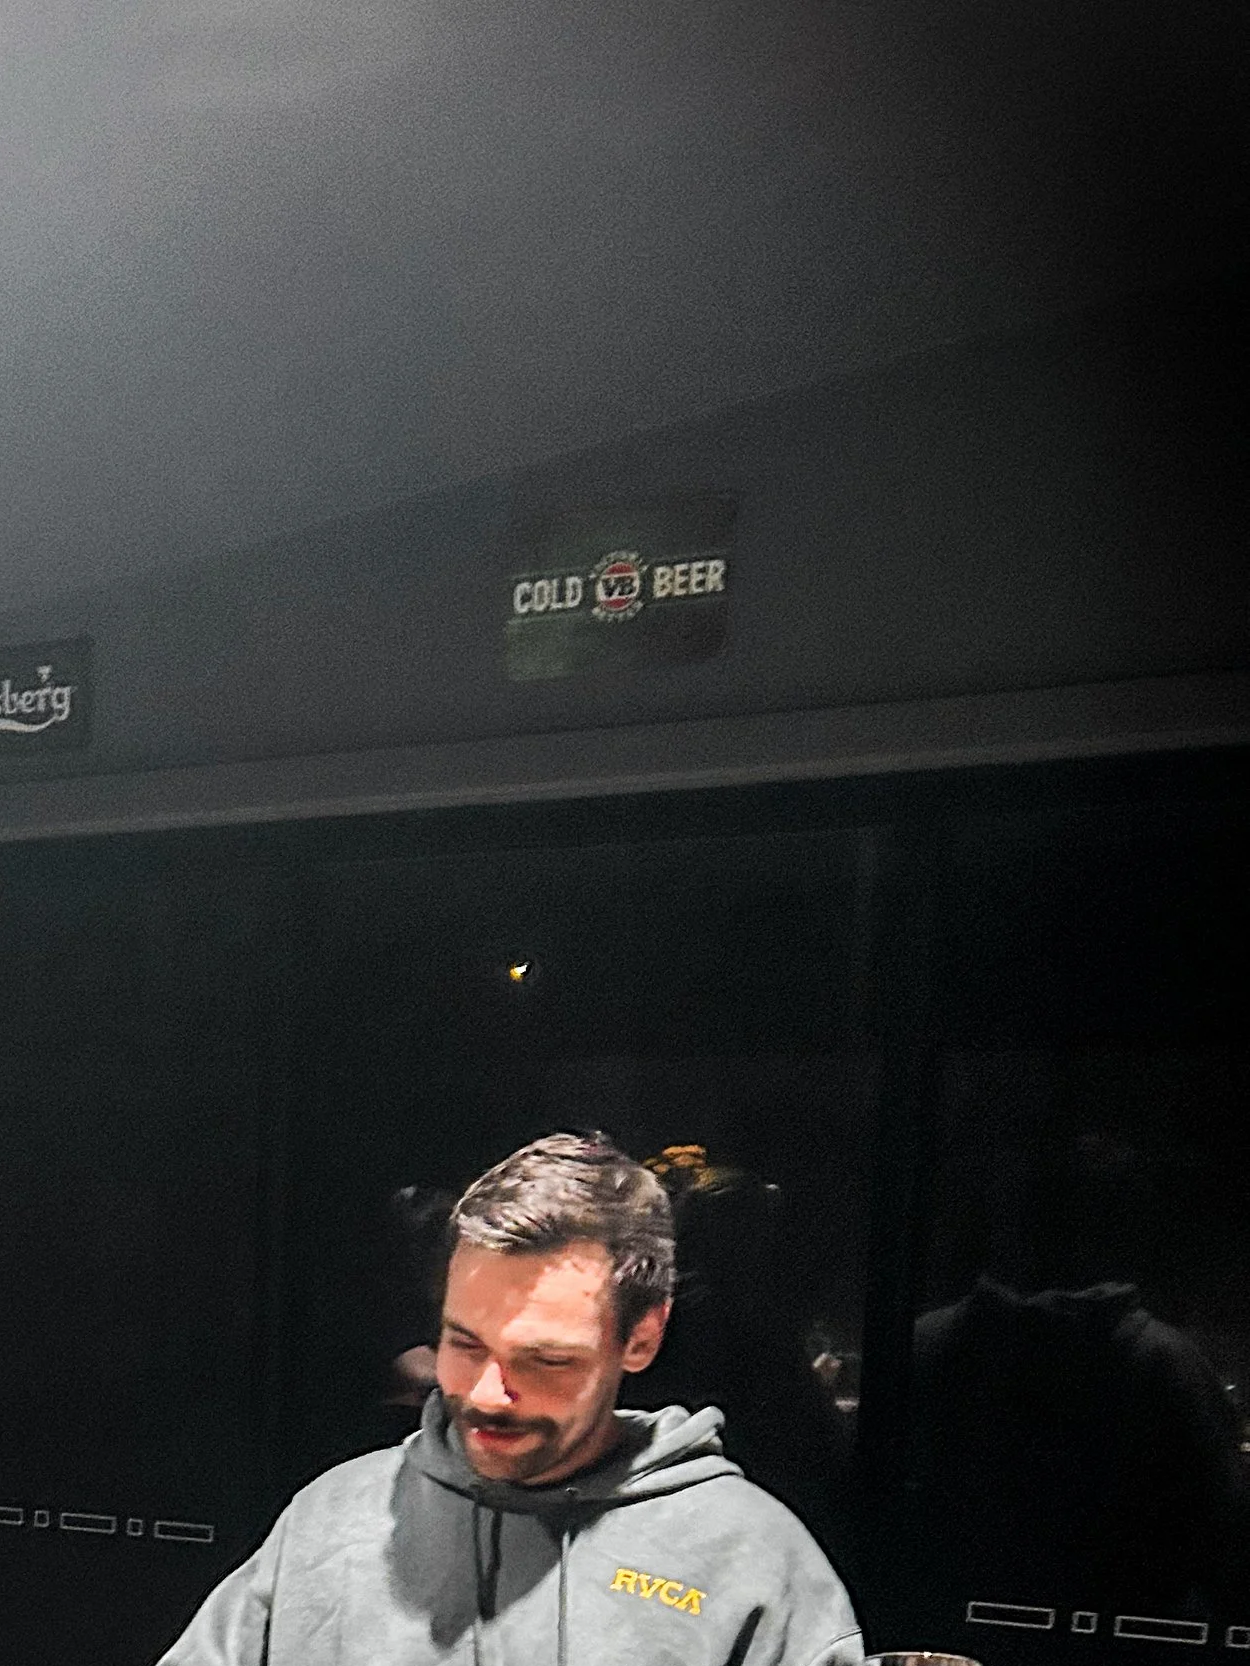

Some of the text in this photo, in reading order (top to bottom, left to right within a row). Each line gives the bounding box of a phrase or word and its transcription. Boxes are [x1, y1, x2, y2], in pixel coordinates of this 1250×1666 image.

[513, 576, 583, 614] COLD
[653, 559, 726, 599] BEER
[610, 1568, 707, 1616] RVCA
